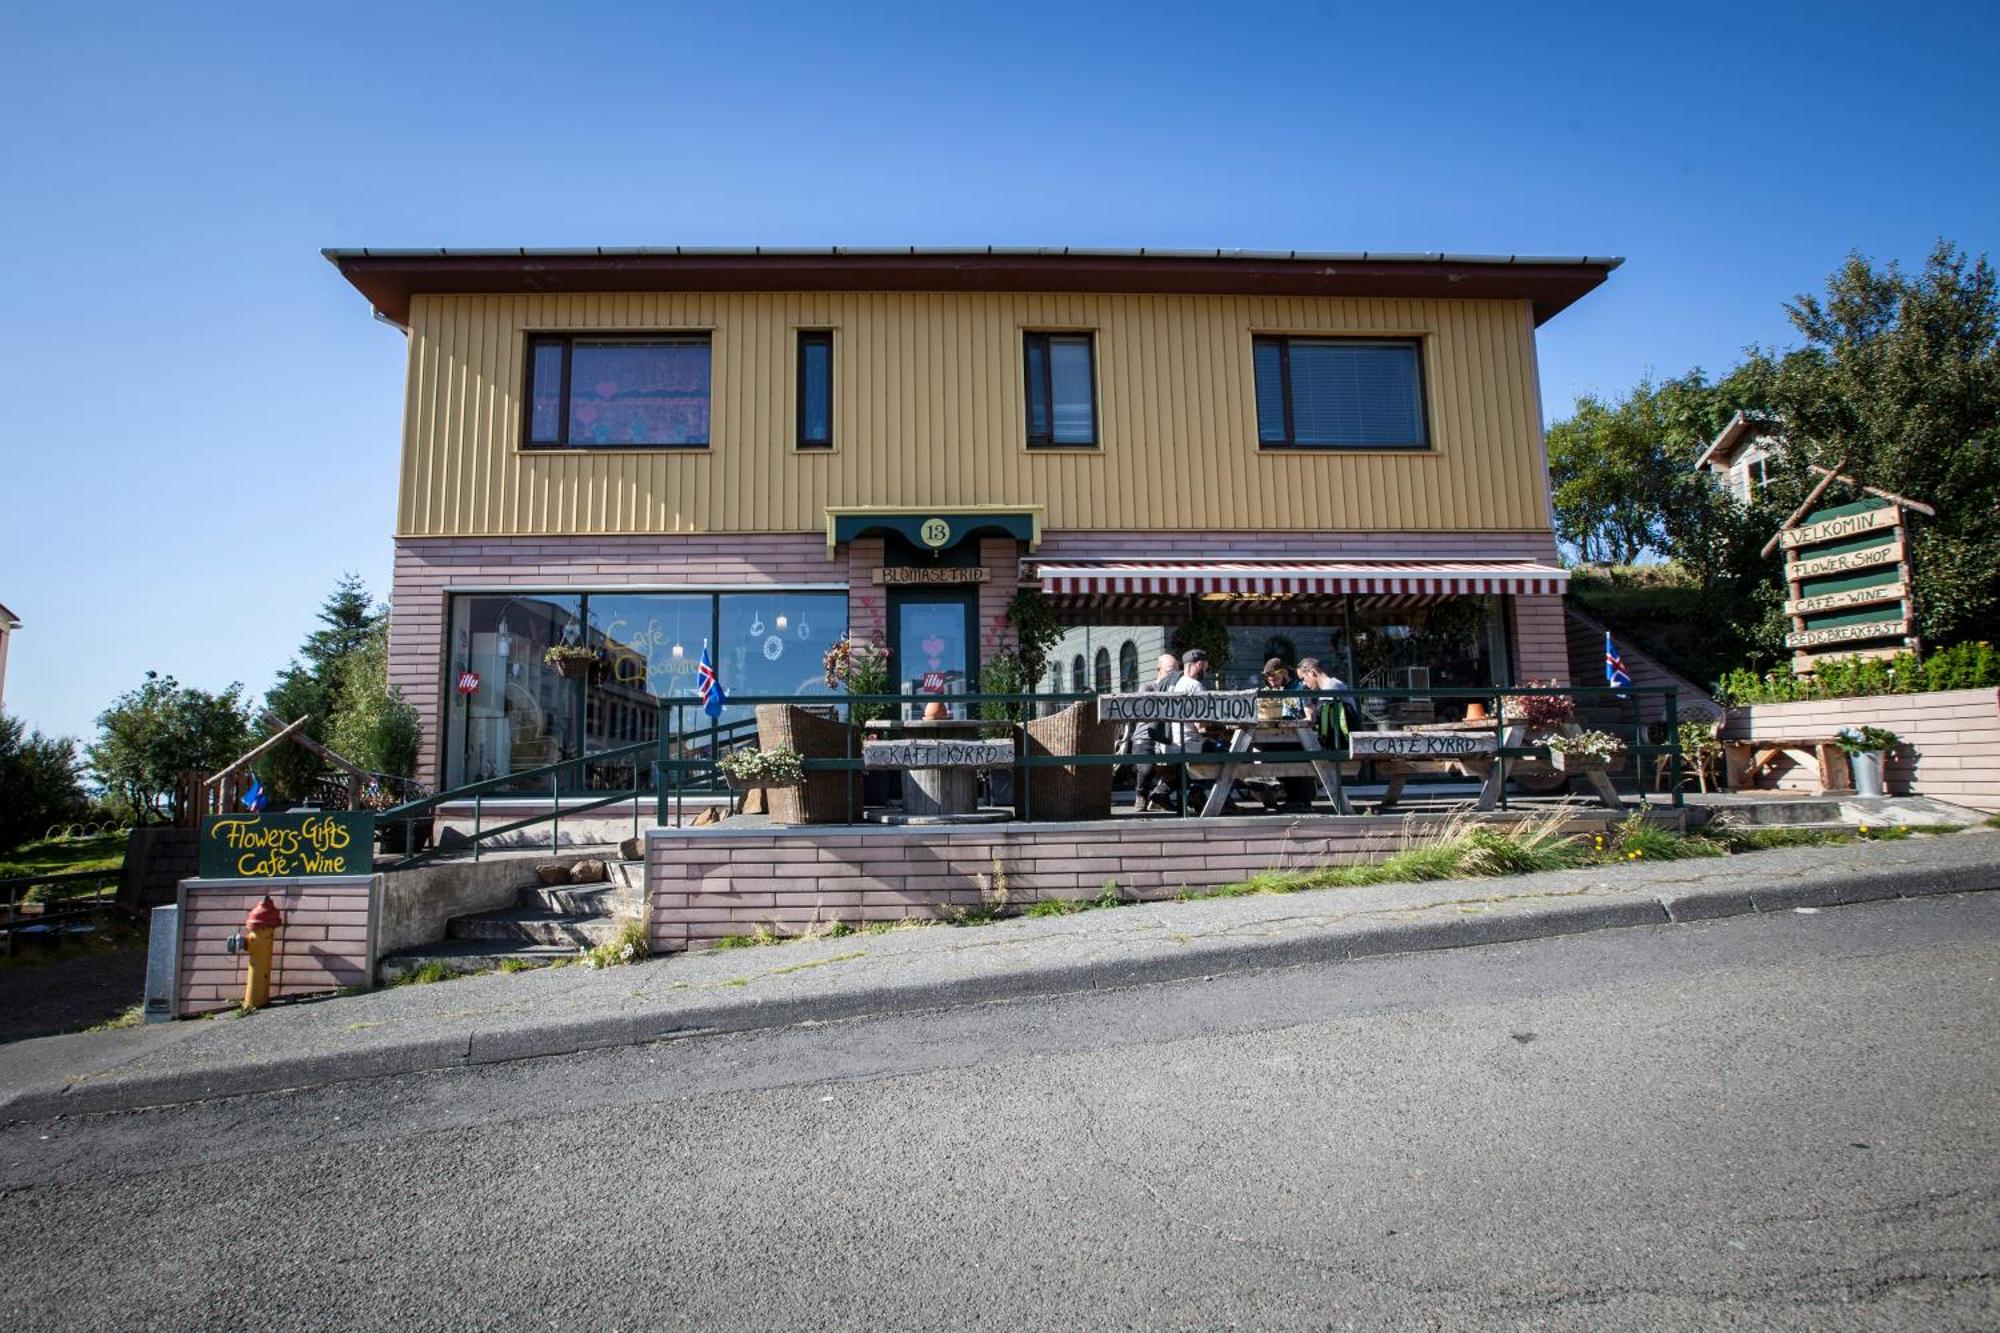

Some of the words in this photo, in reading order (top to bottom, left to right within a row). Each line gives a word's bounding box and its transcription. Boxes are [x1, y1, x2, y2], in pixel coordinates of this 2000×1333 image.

[926, 525, 947, 541] 13
[1792, 555, 1850, 577] FLOWER
[1851, 548, 1892, 567] SHOP
[459, 674, 478, 691] illy
[924, 673, 943, 690] illy
[1108, 695, 1257, 719] ACCOMMODATION
[300, 851, 346, 873] Wine
